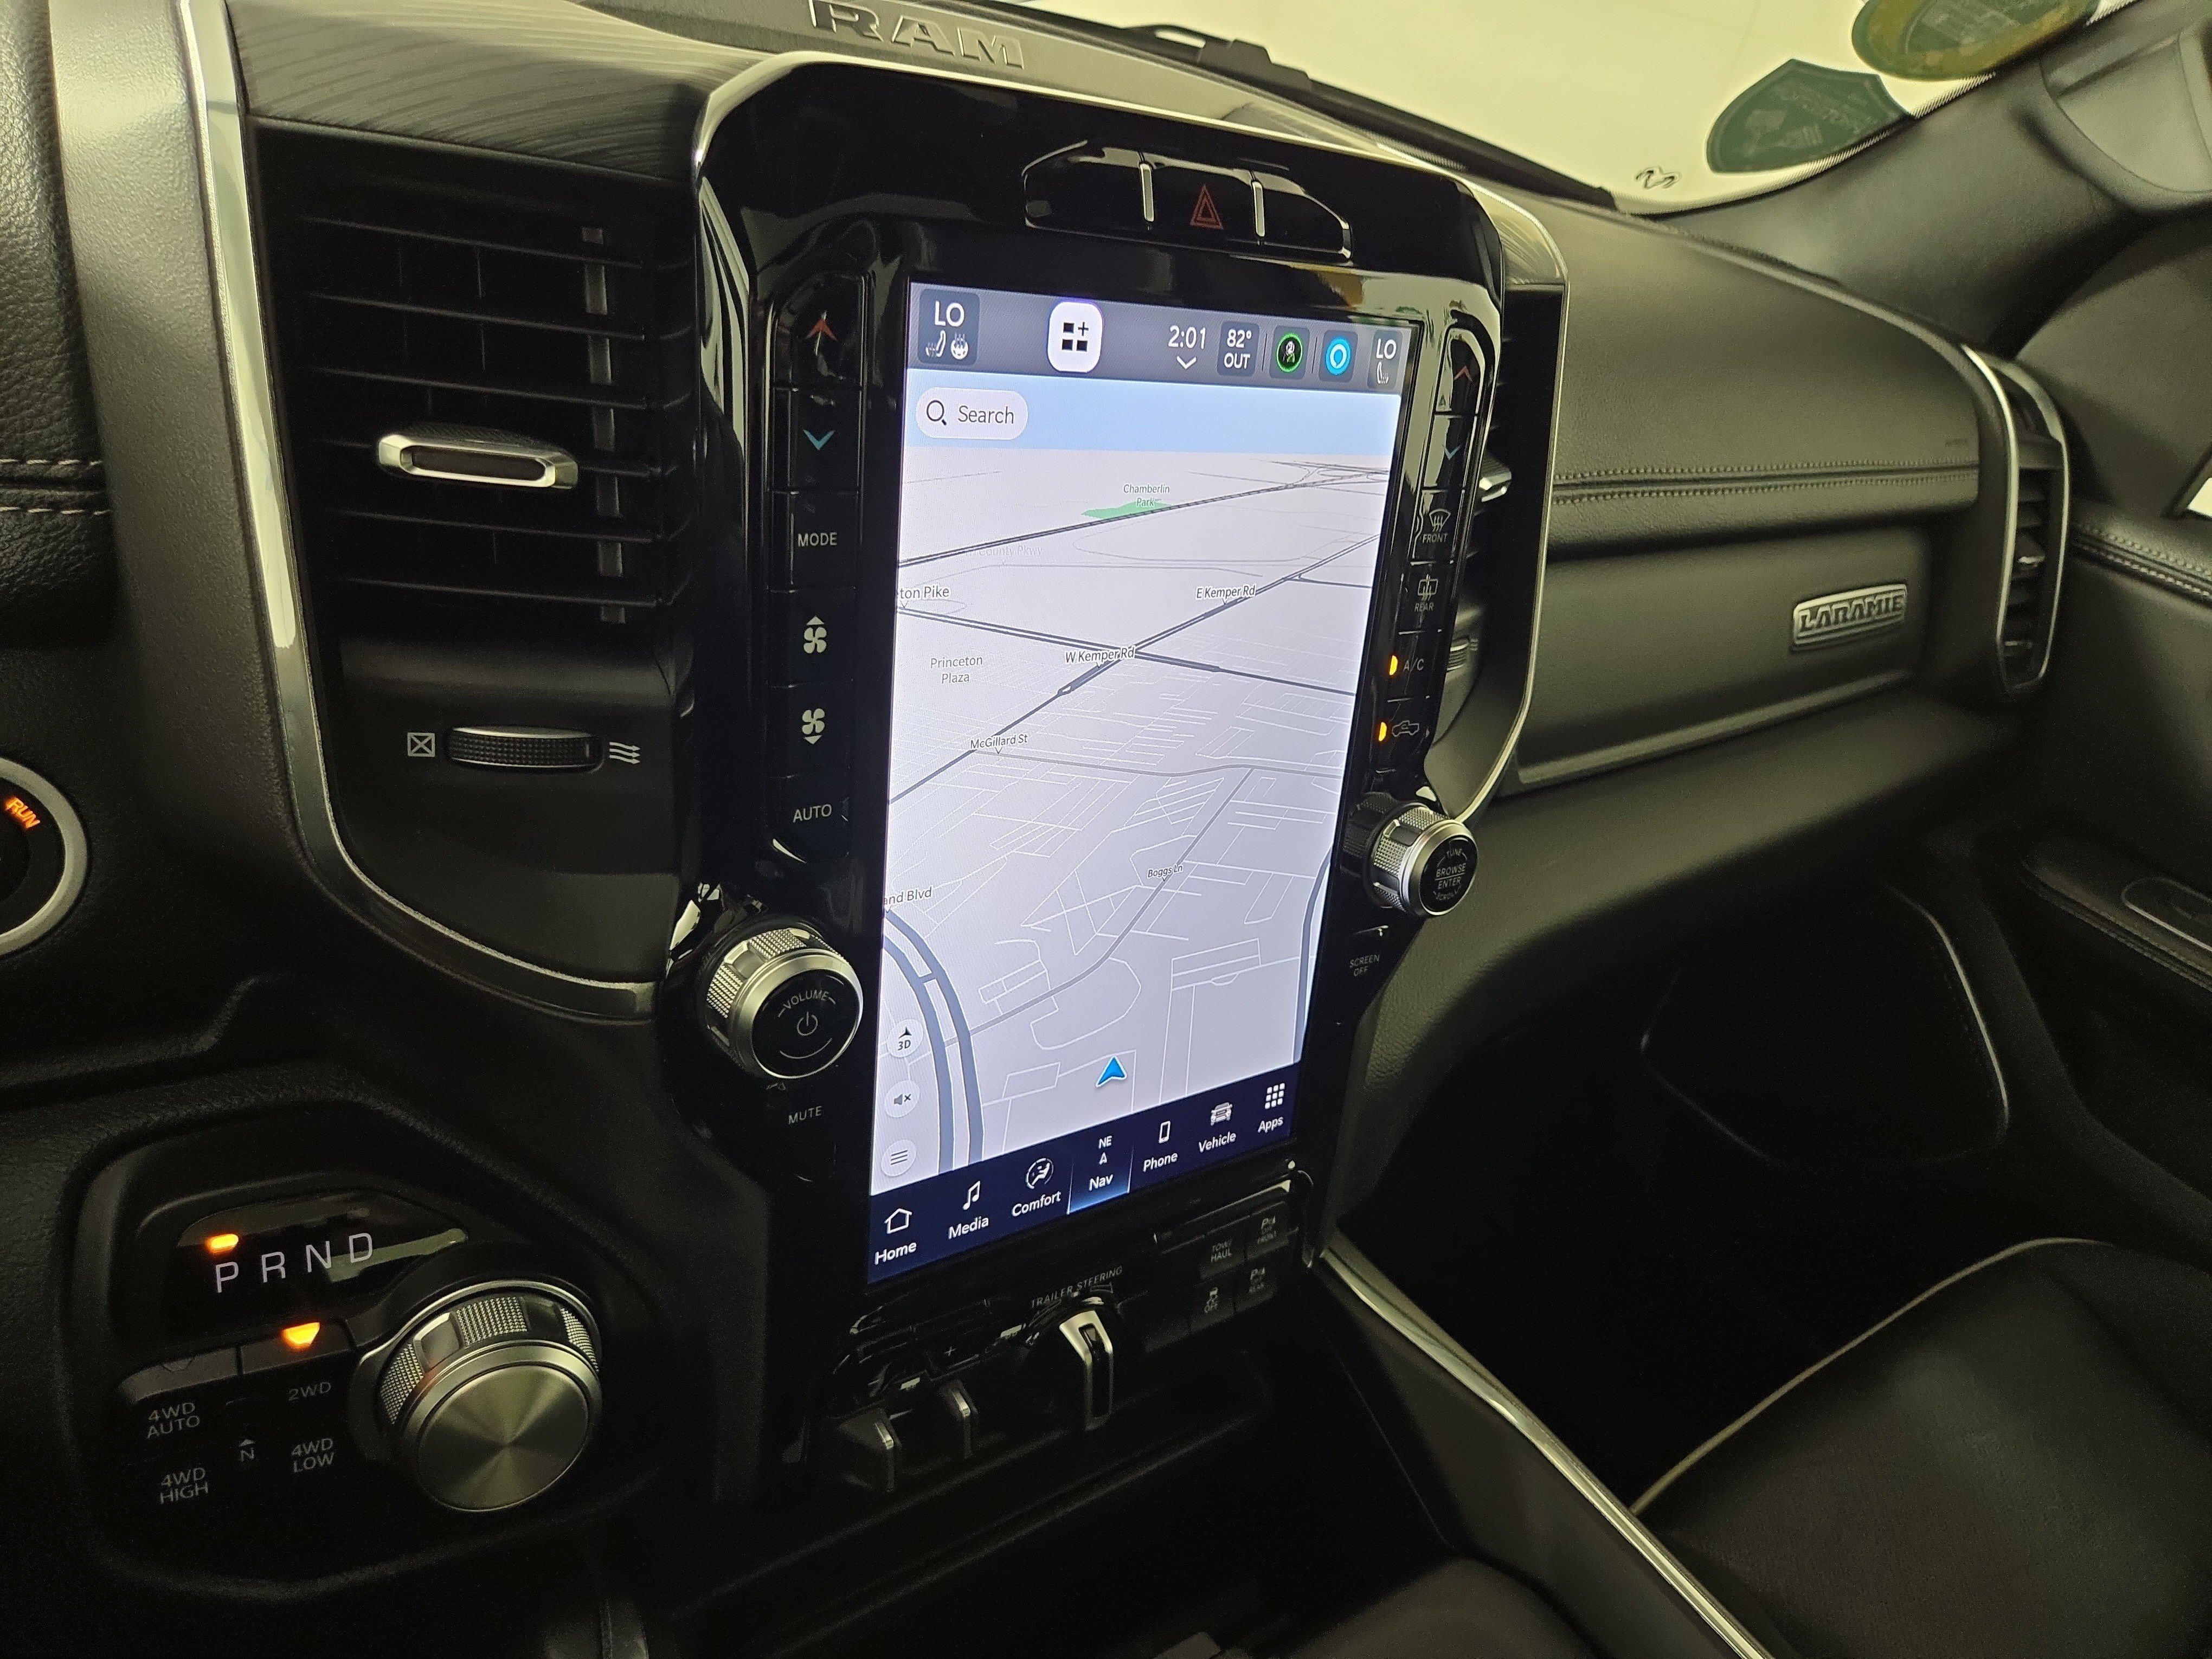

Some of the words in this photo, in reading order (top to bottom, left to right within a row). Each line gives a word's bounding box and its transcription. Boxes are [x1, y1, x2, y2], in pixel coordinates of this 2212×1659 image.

[809, 0, 1024, 69] RAM
[934, 300, 965, 327] LO
[1168, 325, 1206, 350] 2:01
[1226, 329, 1252, 348] 82°
[1376, 338, 1397, 359] LO
[1224, 352, 1251, 369] OUT
[957, 405, 1014, 424] Search
[1123, 484, 1170, 493] Chamberlin
[1136, 497, 1155, 507] Park
[798, 532, 838, 547] MODE
[1422, 533, 1449, 543] FRONT
[924, 585, 949, 598] Pike
[1197, 587, 1203, 599] E
[1204, 587, 1241, 599] Kemper
[1243, 585, 1256, 596] Rd
[1414, 603, 1433, 612] REAR
[1799, 593, 1905, 632] LARAMIE
[930, 656, 983, 668] Princeton
[1065, 652, 1077, 663] W
[1078, 650, 1120, 664] Kemper
[1121, 647, 1135, 659] Rd
[1403, 658, 1424, 671] A/C
[942, 672, 970, 684] Plaza
[970, 735, 1016, 749] McGillard
[1018, 734, 1028, 744] St
[7, 797, 41, 828] RUN
[793, 804, 832, 823] AUTO
[1446, 848, 1463, 857] TUNE
[1148, 866, 1173, 878] Boggs
[1173, 864, 1183, 873] Ln
[1436, 863, 1467, 878] BROWSE
[1438, 876, 1462, 889] ENTER
[907, 886, 932, 901] Blvd
[1349, 954, 1380, 968] SCREEN
[1353, 966, 1368, 976] OFF
[784, 989, 829, 1009] VOLUME
[897, 1039, 911, 1051] 3D
[788, 1105, 822, 1125] MUTE
[1258, 1116, 1284, 1133] Apps
[1098, 1135, 1113, 1149] NE
[1198, 1131, 1237, 1153] Vehicle
[1143, 1153, 1178, 1172] Phone
[1089, 1174, 1114, 1191] Nav
[1011, 1190, 1062, 1217] Comfort
[948, 1216, 989, 1239] Media
[874, 1242, 917, 1264] Home
[1211, 1248, 1232, 1263] HAUL
[215, 1261, 239, 1293] P
[261, 1251, 286, 1283] R
[305, 1240, 332, 1272] N
[349, 1232, 373, 1263] D
[1031, 1285, 1073, 1308] TRAILER
[1077, 1265, 1123, 1290] STEERING
[288, 1381, 332, 1401] 2WD
[148, 1402, 196, 1422] 4WD
[147, 1415, 201, 1439] AUTO
[239, 1448, 255, 1462] N
[291, 1438, 333, 1457] 4WD
[293, 1452, 335, 1474] LOW
[160, 1467, 207, 1488] 4WD
[159, 1481, 209, 1504] HIGH
